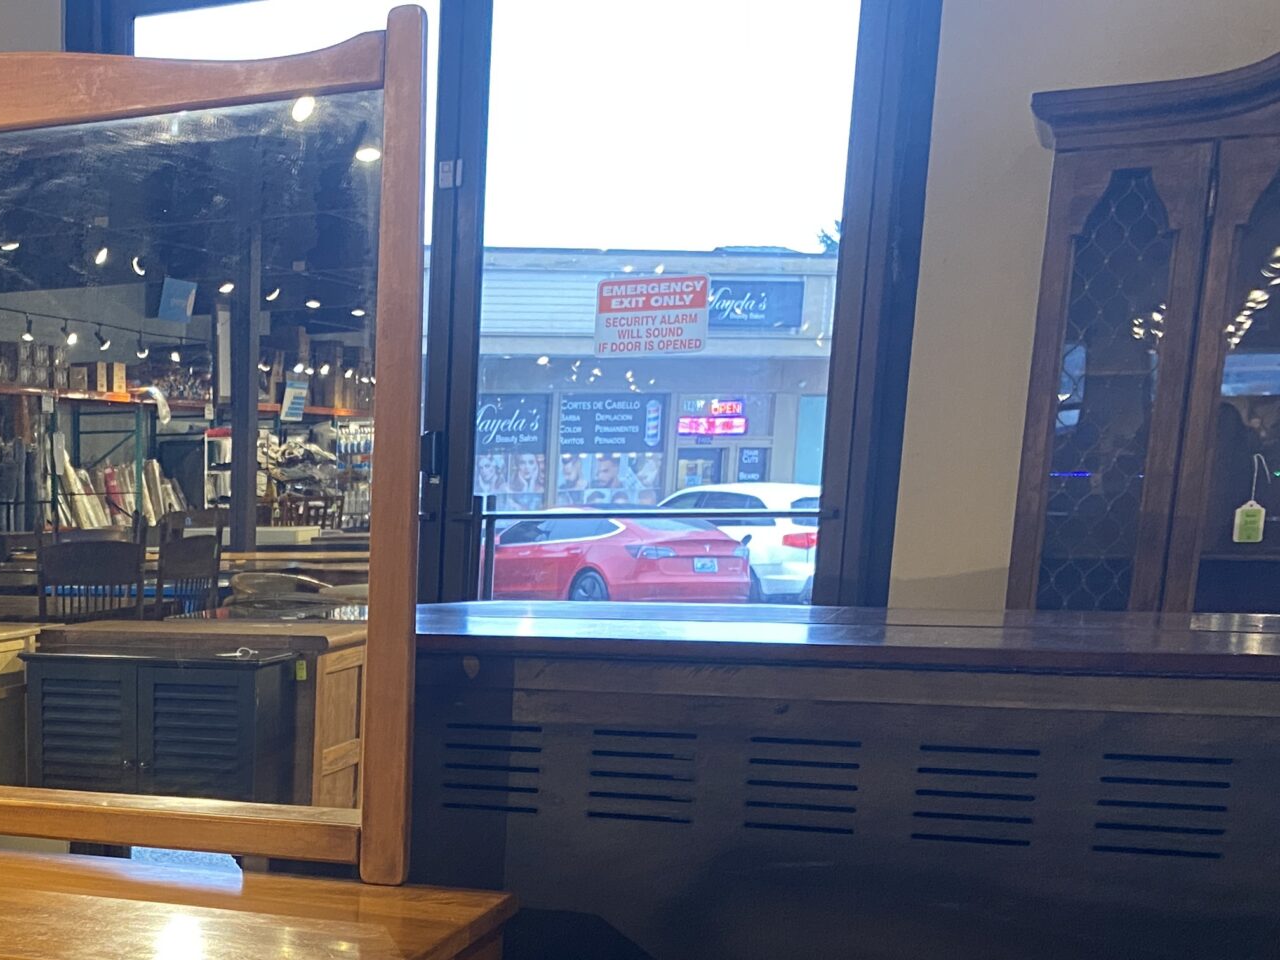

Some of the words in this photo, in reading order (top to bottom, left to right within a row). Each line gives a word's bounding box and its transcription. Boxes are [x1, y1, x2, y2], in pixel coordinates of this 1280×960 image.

[602, 280, 705, 297] EMERGENCY
[611, 297, 646, 309] EXIT
[650, 294, 695, 307] ONLY
[605, 315, 657, 328] SECURITY
[660, 313, 698, 325] ALARM
[617, 329, 643, 340] WILL
[645, 327, 684, 338] SOUND
[598, 343, 609, 353] IF
[611, 342, 641, 352] DOOR
[644, 341, 654, 351] IS
[658, 339, 702, 351] OPENED
[710, 402, 742, 415] OPEN
[495, 435, 518, 445] Beauty
[519, 433, 538, 443] Salon
